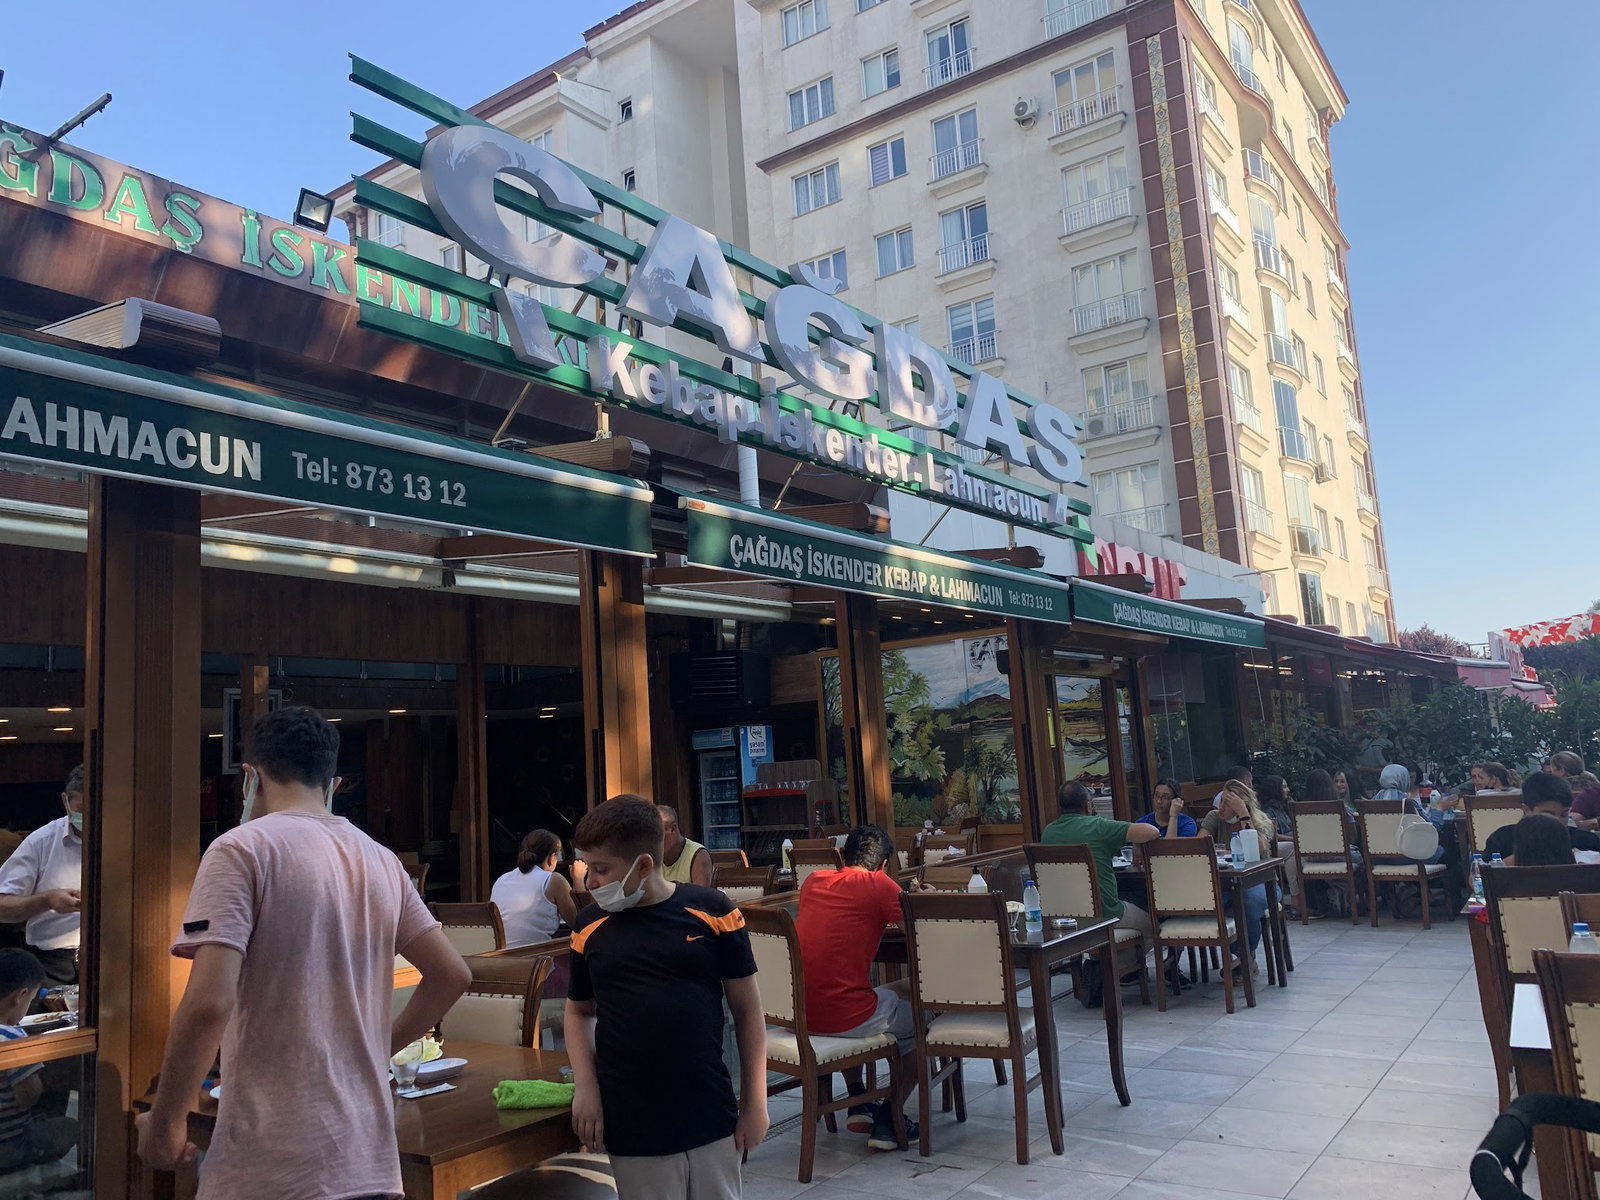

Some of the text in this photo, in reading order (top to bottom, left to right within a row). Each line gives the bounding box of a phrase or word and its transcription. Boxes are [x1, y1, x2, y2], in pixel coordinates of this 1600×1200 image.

[241, 208, 512, 346] İSKENDE
[1, 396, 467, 507] AHMACUN Tel: 873 13 12
[730, 534, 803, 579] ÇAĞDAŞ
[807, 544, 882, 587] İSKENDER
[884, 565, 927, 594] KEBAP
[929, 574, 940, 597] &
[941, 576, 1003, 607] LAHMACUN
[1021, 592, 1034, 607] 873
[1036, 595, 1044, 610] 13
[1044, 597, 1053, 611] 12
